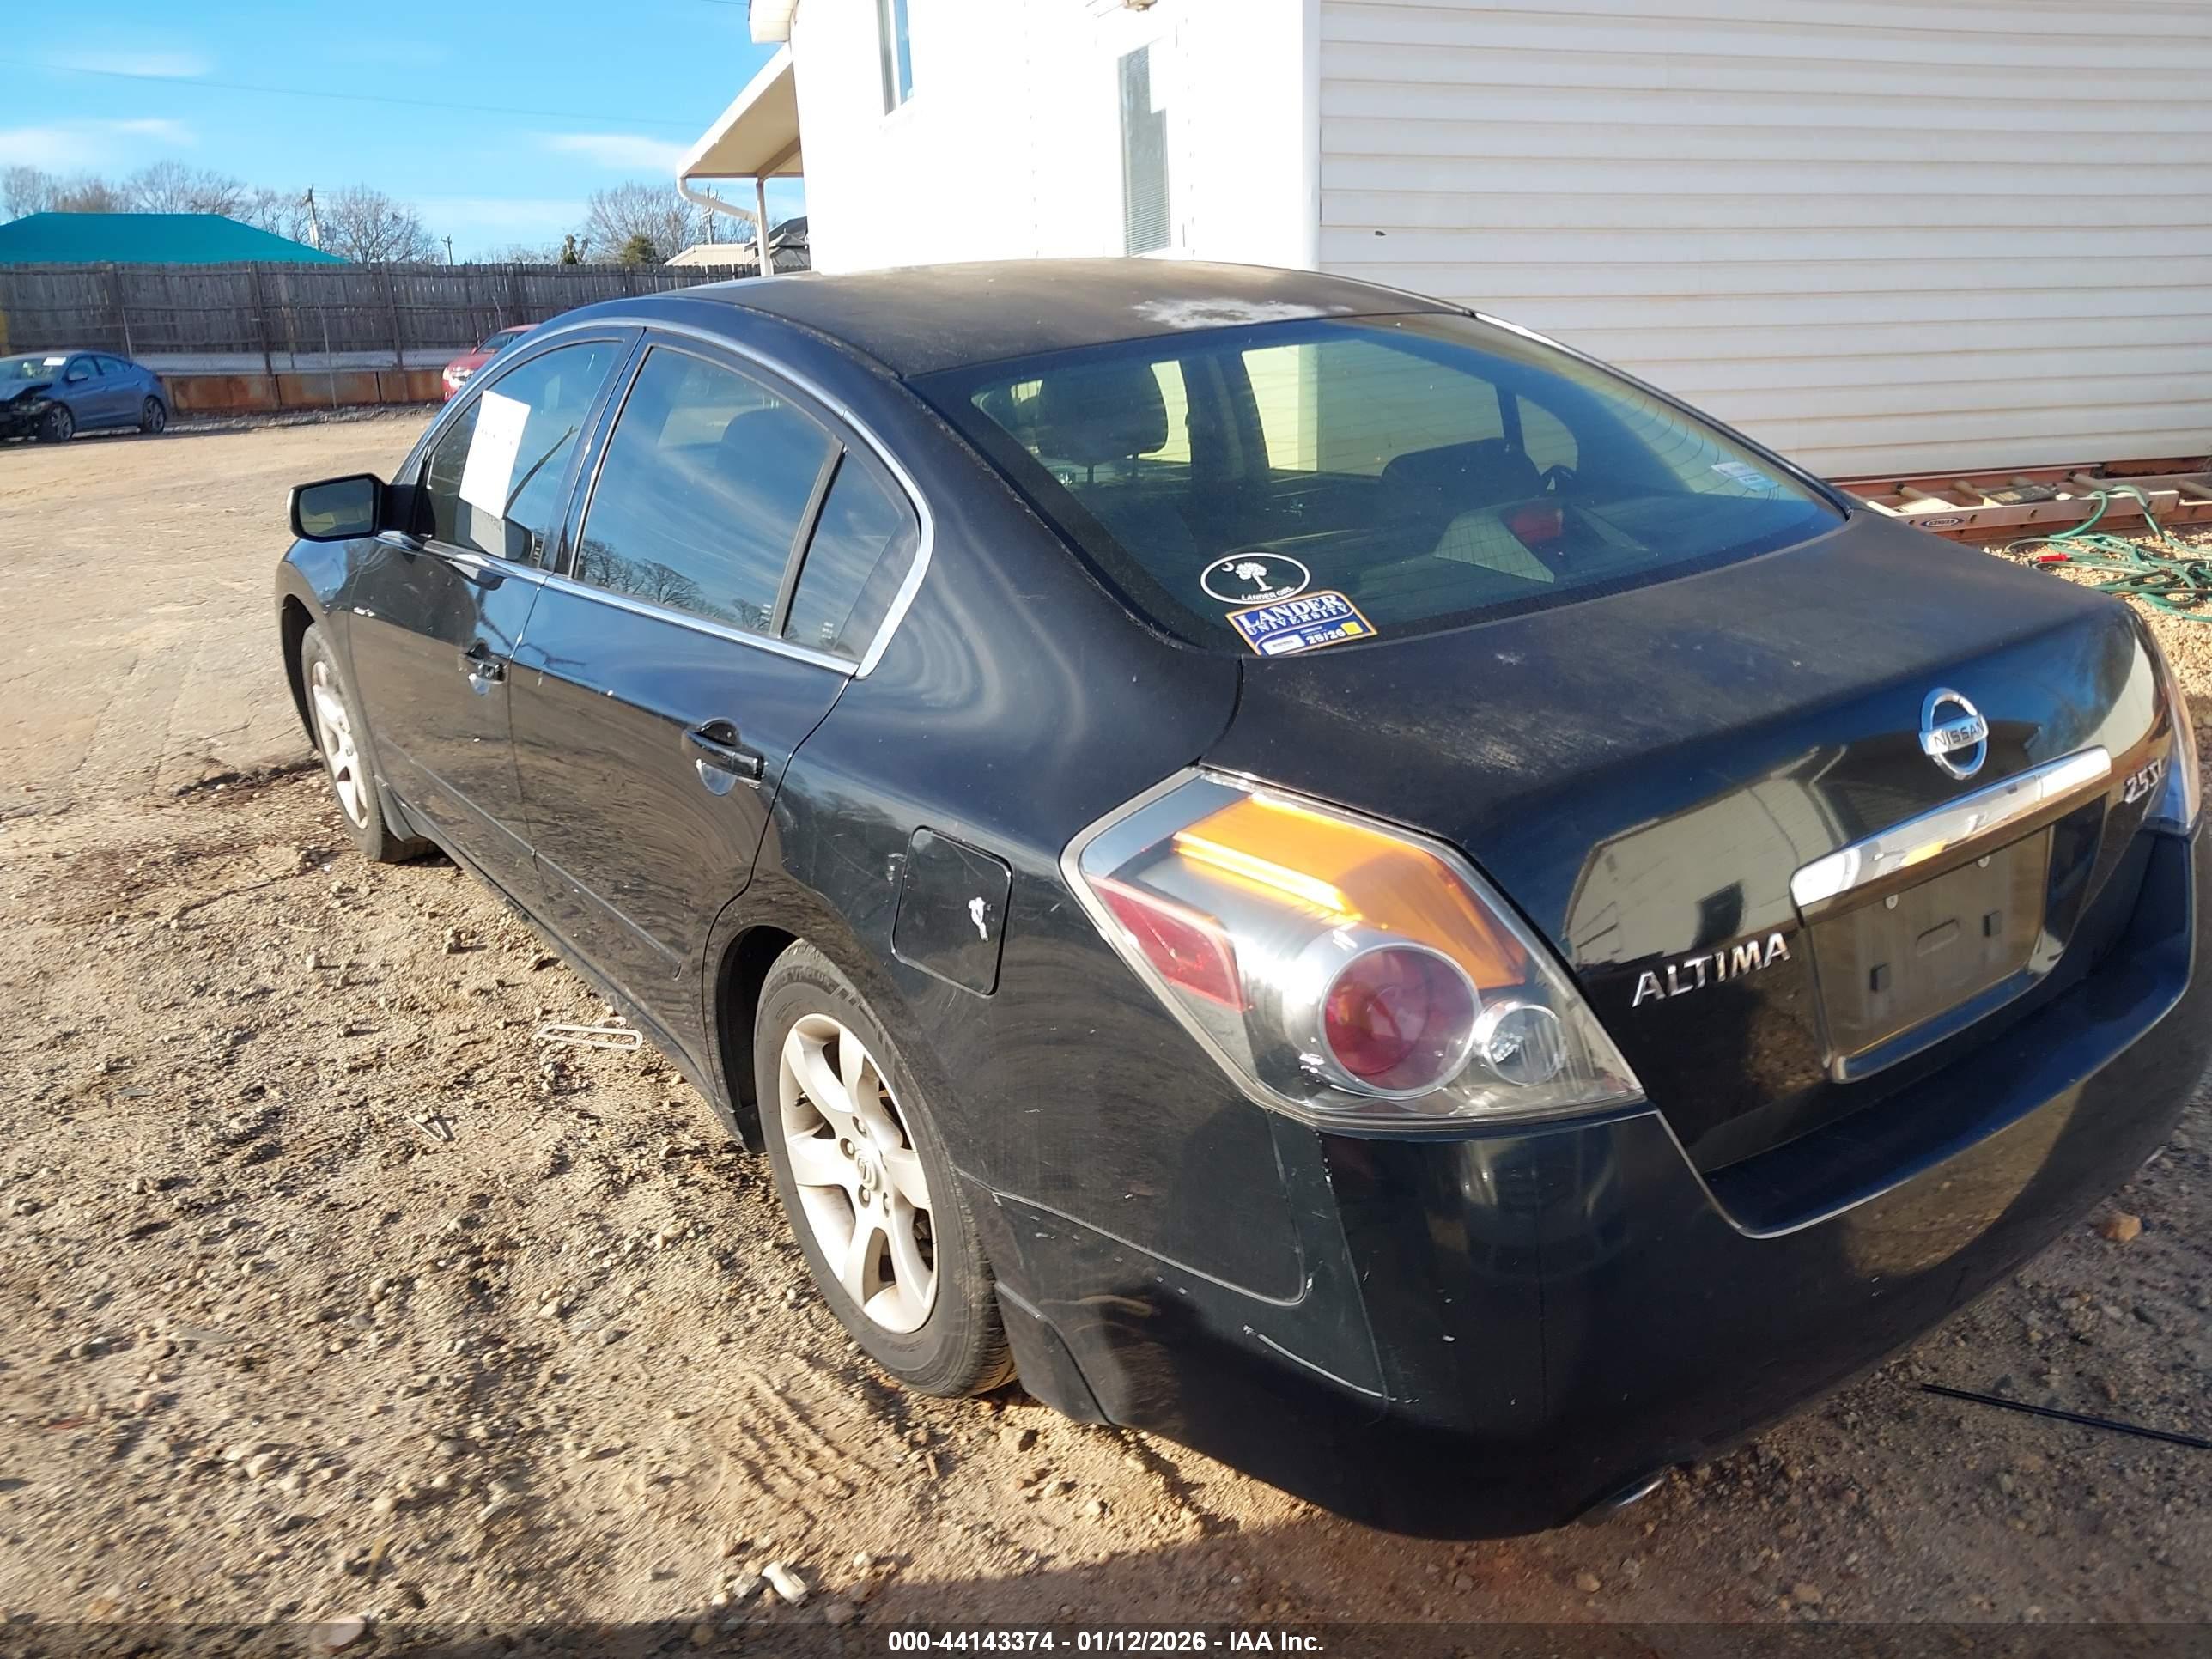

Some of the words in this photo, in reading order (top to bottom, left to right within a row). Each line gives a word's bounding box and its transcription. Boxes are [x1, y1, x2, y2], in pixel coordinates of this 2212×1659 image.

[1241, 592, 1277, 601] LANDER
[1276, 586, 1295, 596] GIRL
[1235, 594, 1344, 629] LANDER
[1245, 605, 1349, 636] UNIVERSITY
[1305, 628, 1346, 645] 25/26
[1932, 721, 1984, 747] NISSAN
[1632, 932, 1791, 1008] ALTIMA
